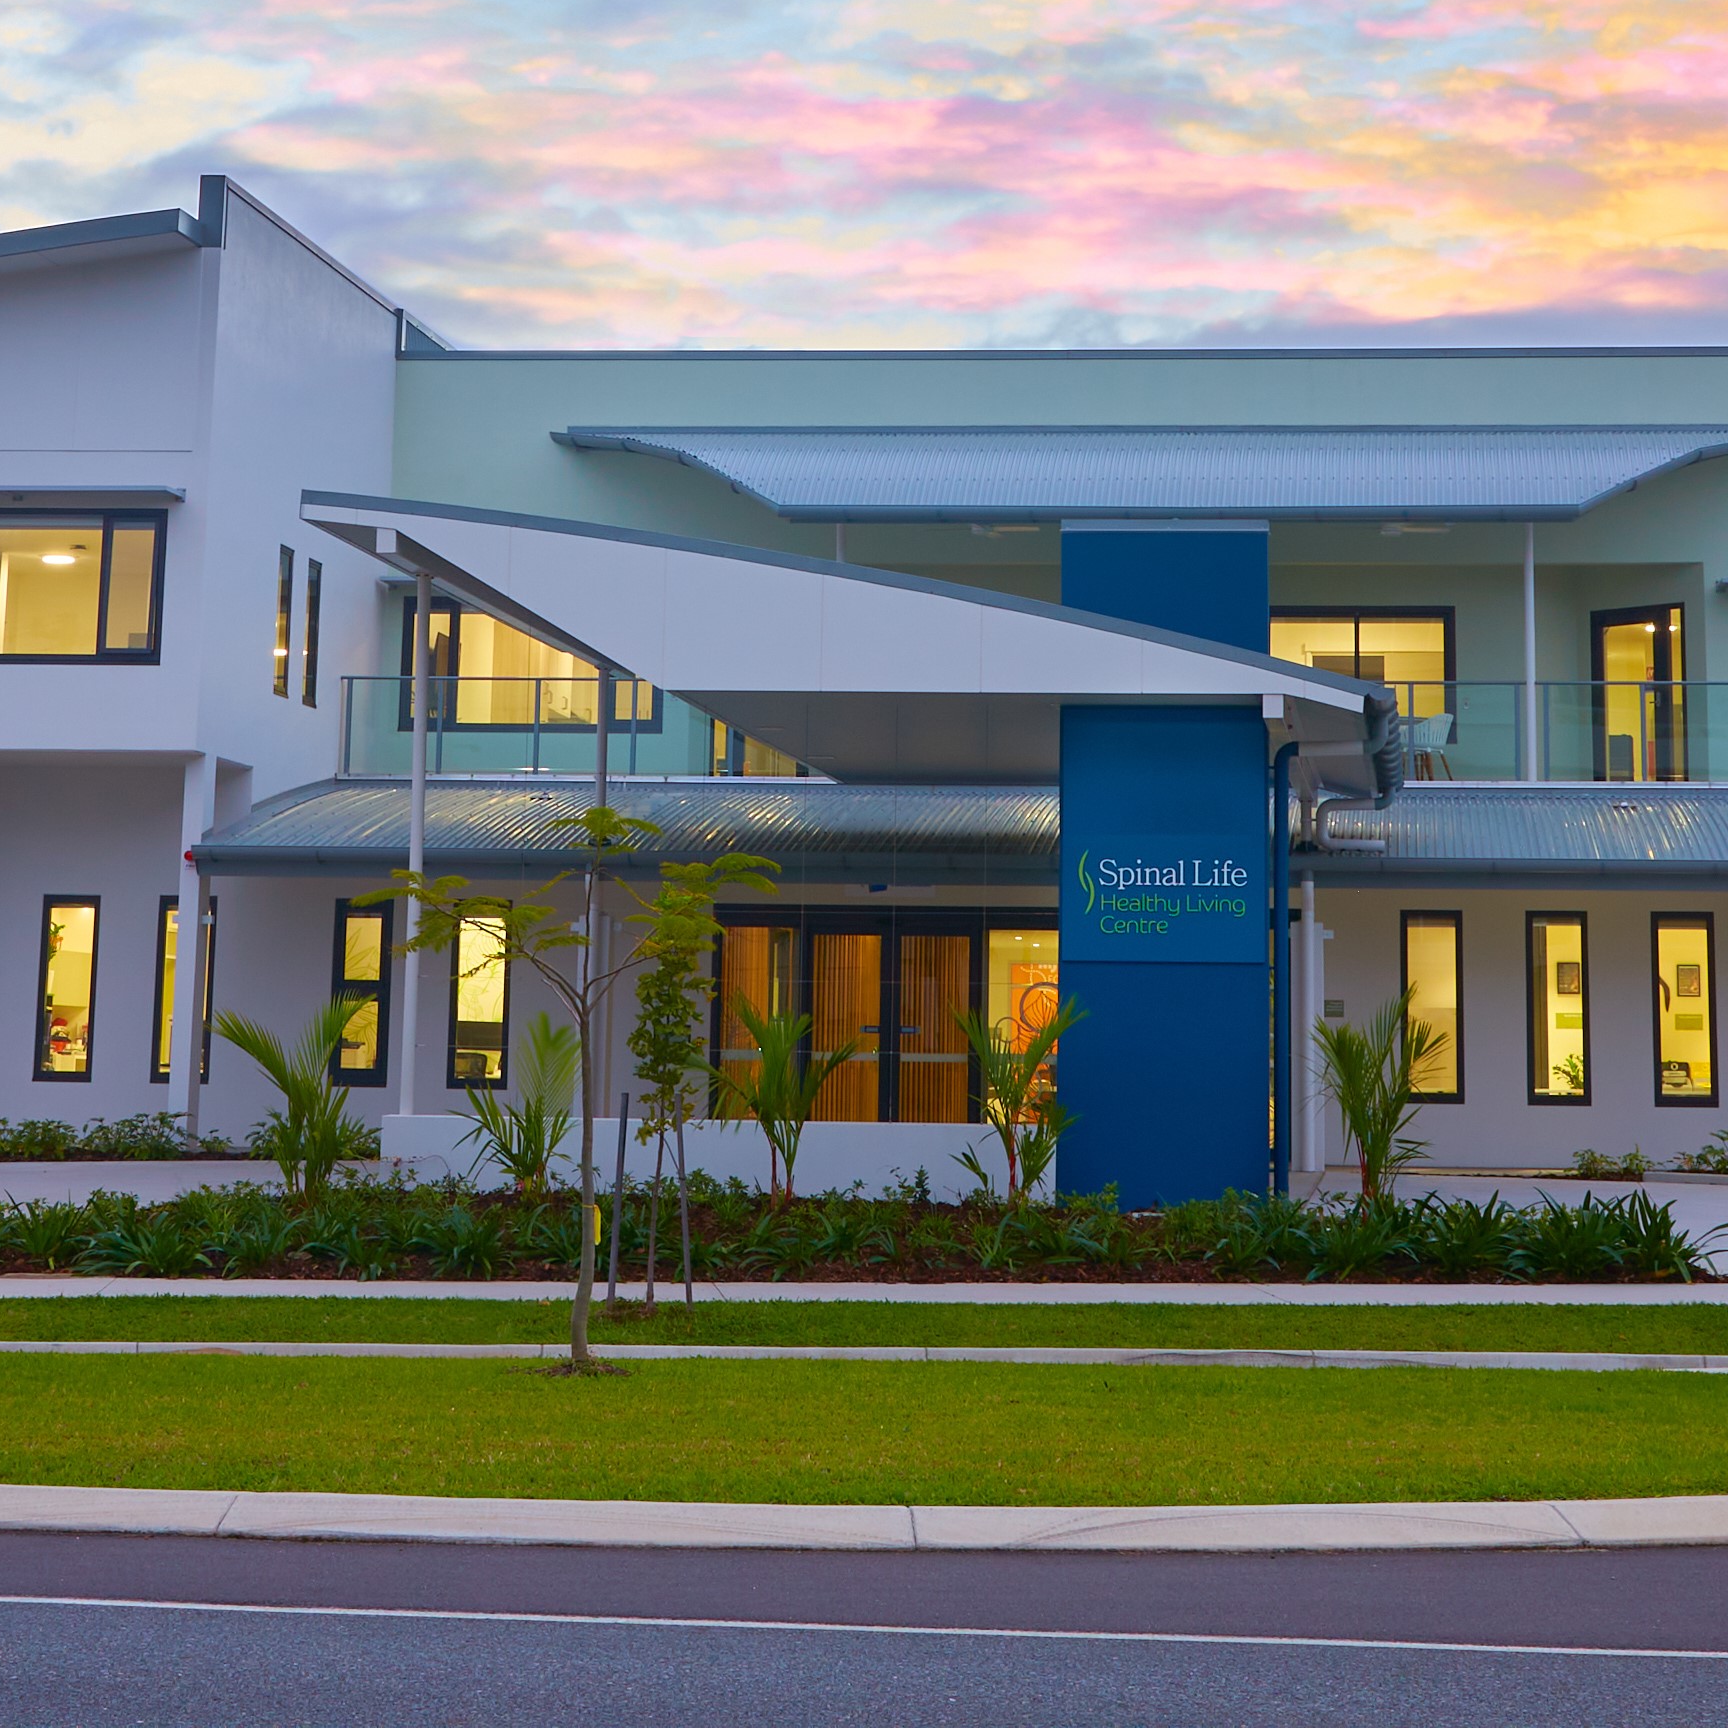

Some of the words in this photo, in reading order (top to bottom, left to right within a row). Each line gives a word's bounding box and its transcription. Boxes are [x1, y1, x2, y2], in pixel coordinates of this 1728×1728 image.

[1098, 858, 1185, 890] Spinal
[1192, 859, 1248, 887] Life
[1100, 893, 1180, 917] Healthy
[1186, 894, 1246, 917] Living
[1100, 915, 1168, 934] Centre
